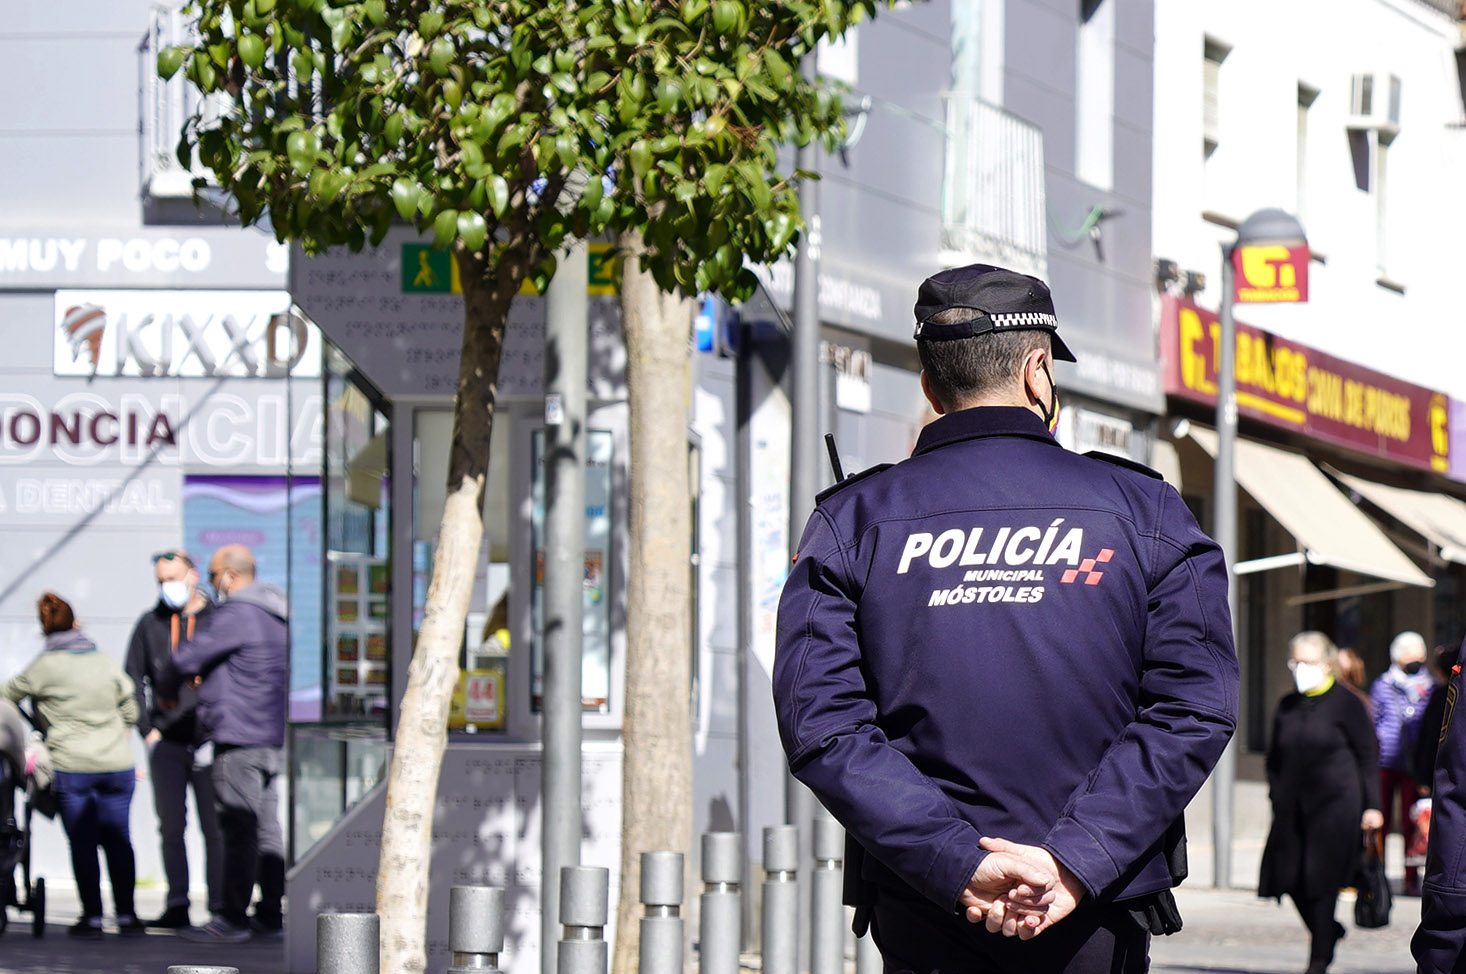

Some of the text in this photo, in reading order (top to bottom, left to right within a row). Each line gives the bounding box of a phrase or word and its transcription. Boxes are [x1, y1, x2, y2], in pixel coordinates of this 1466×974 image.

[0, 238, 211, 272] MUY POCO
[897, 518, 1083, 574] POLICÍA
[963, 569, 1044, 582] MUNICIPAL
[928, 584, 1045, 607] MÓSTOLES
